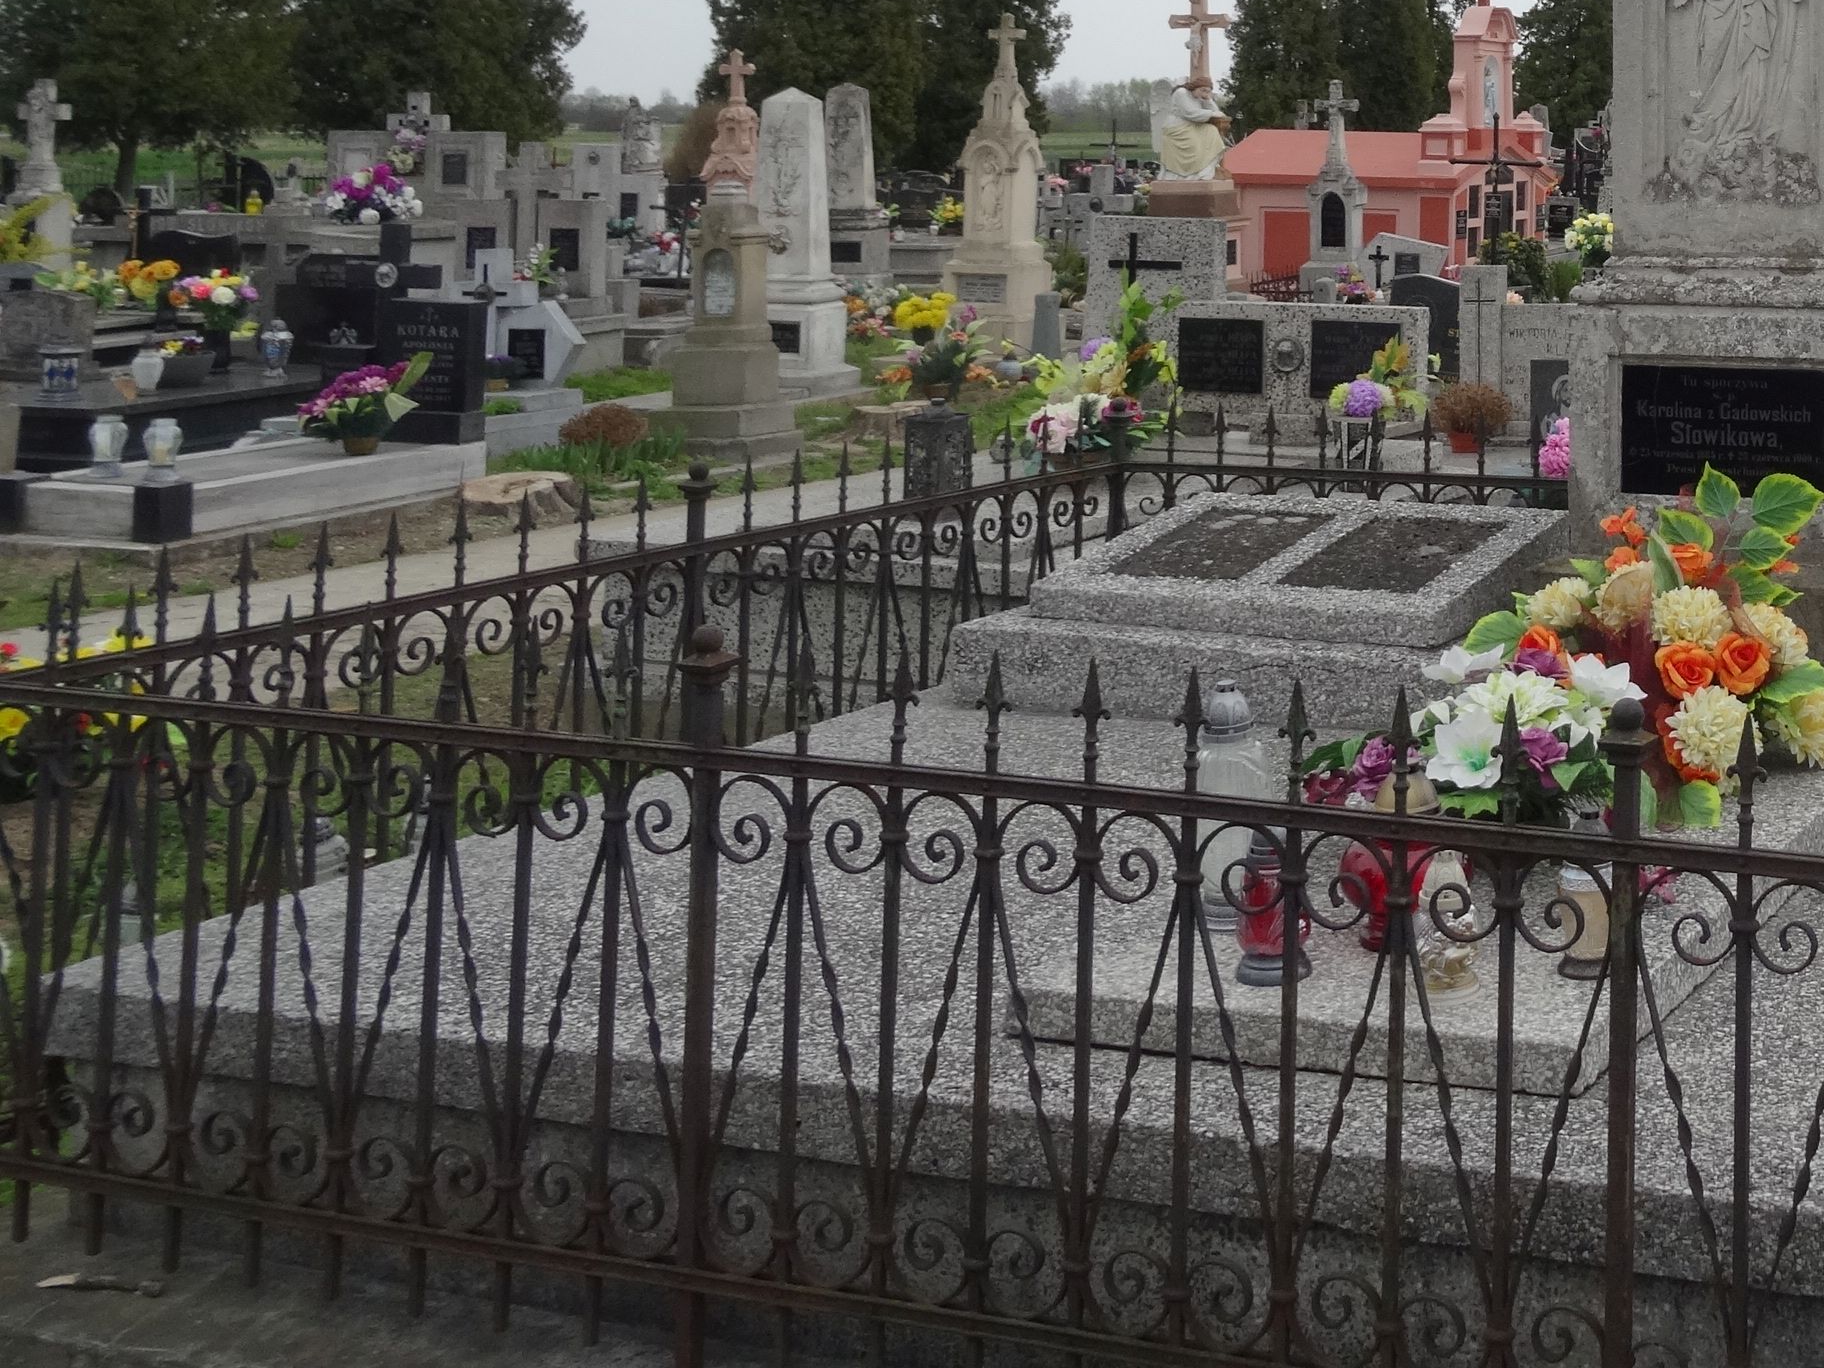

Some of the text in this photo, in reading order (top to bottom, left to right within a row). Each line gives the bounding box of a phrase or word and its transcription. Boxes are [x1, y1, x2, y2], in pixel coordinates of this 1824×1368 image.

[396, 324, 460, 338] KOTARA
[1636, 400, 1811, 424] Karolina z Gadowskich
[1670, 420, 1784, 451] Słowikowa,
